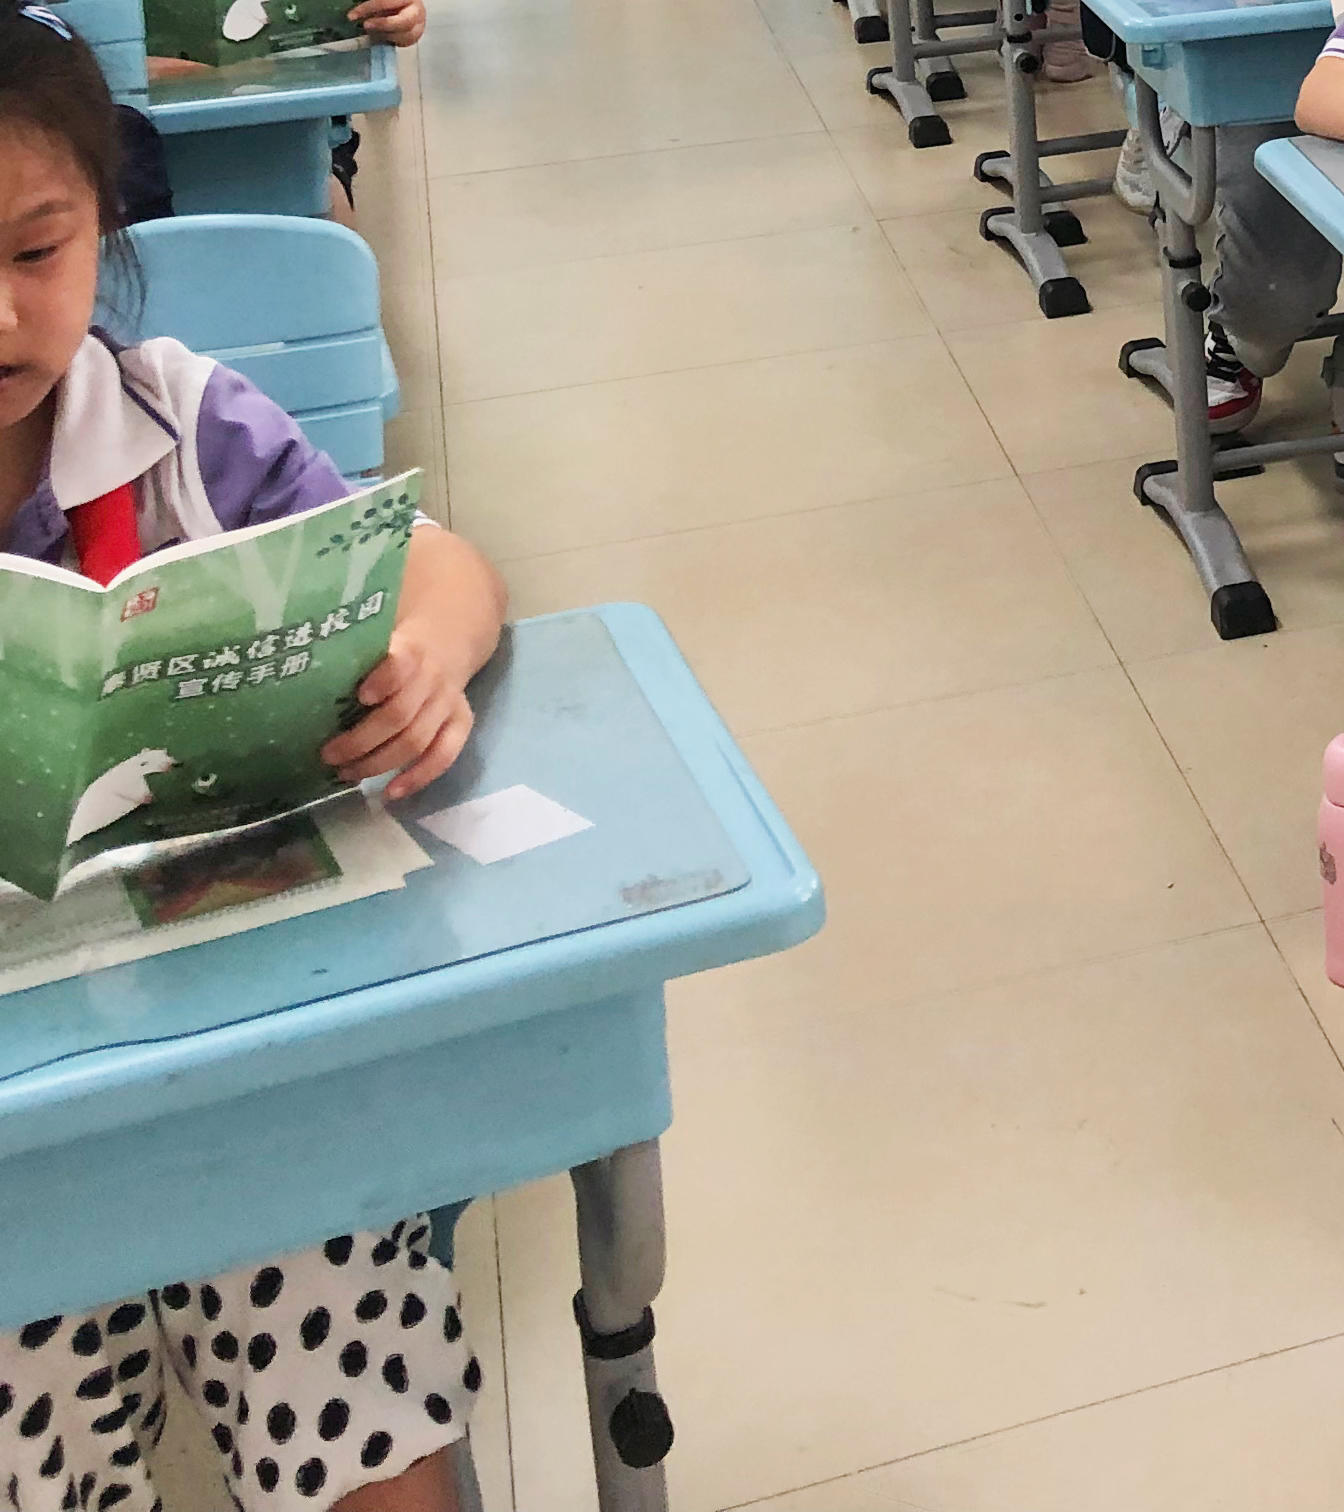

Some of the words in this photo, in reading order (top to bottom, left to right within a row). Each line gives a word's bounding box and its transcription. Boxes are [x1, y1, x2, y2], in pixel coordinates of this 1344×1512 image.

[101, 591, 384, 698] 奉贤区诚信进校园
[175, 651, 310, 699] 宣传手册
